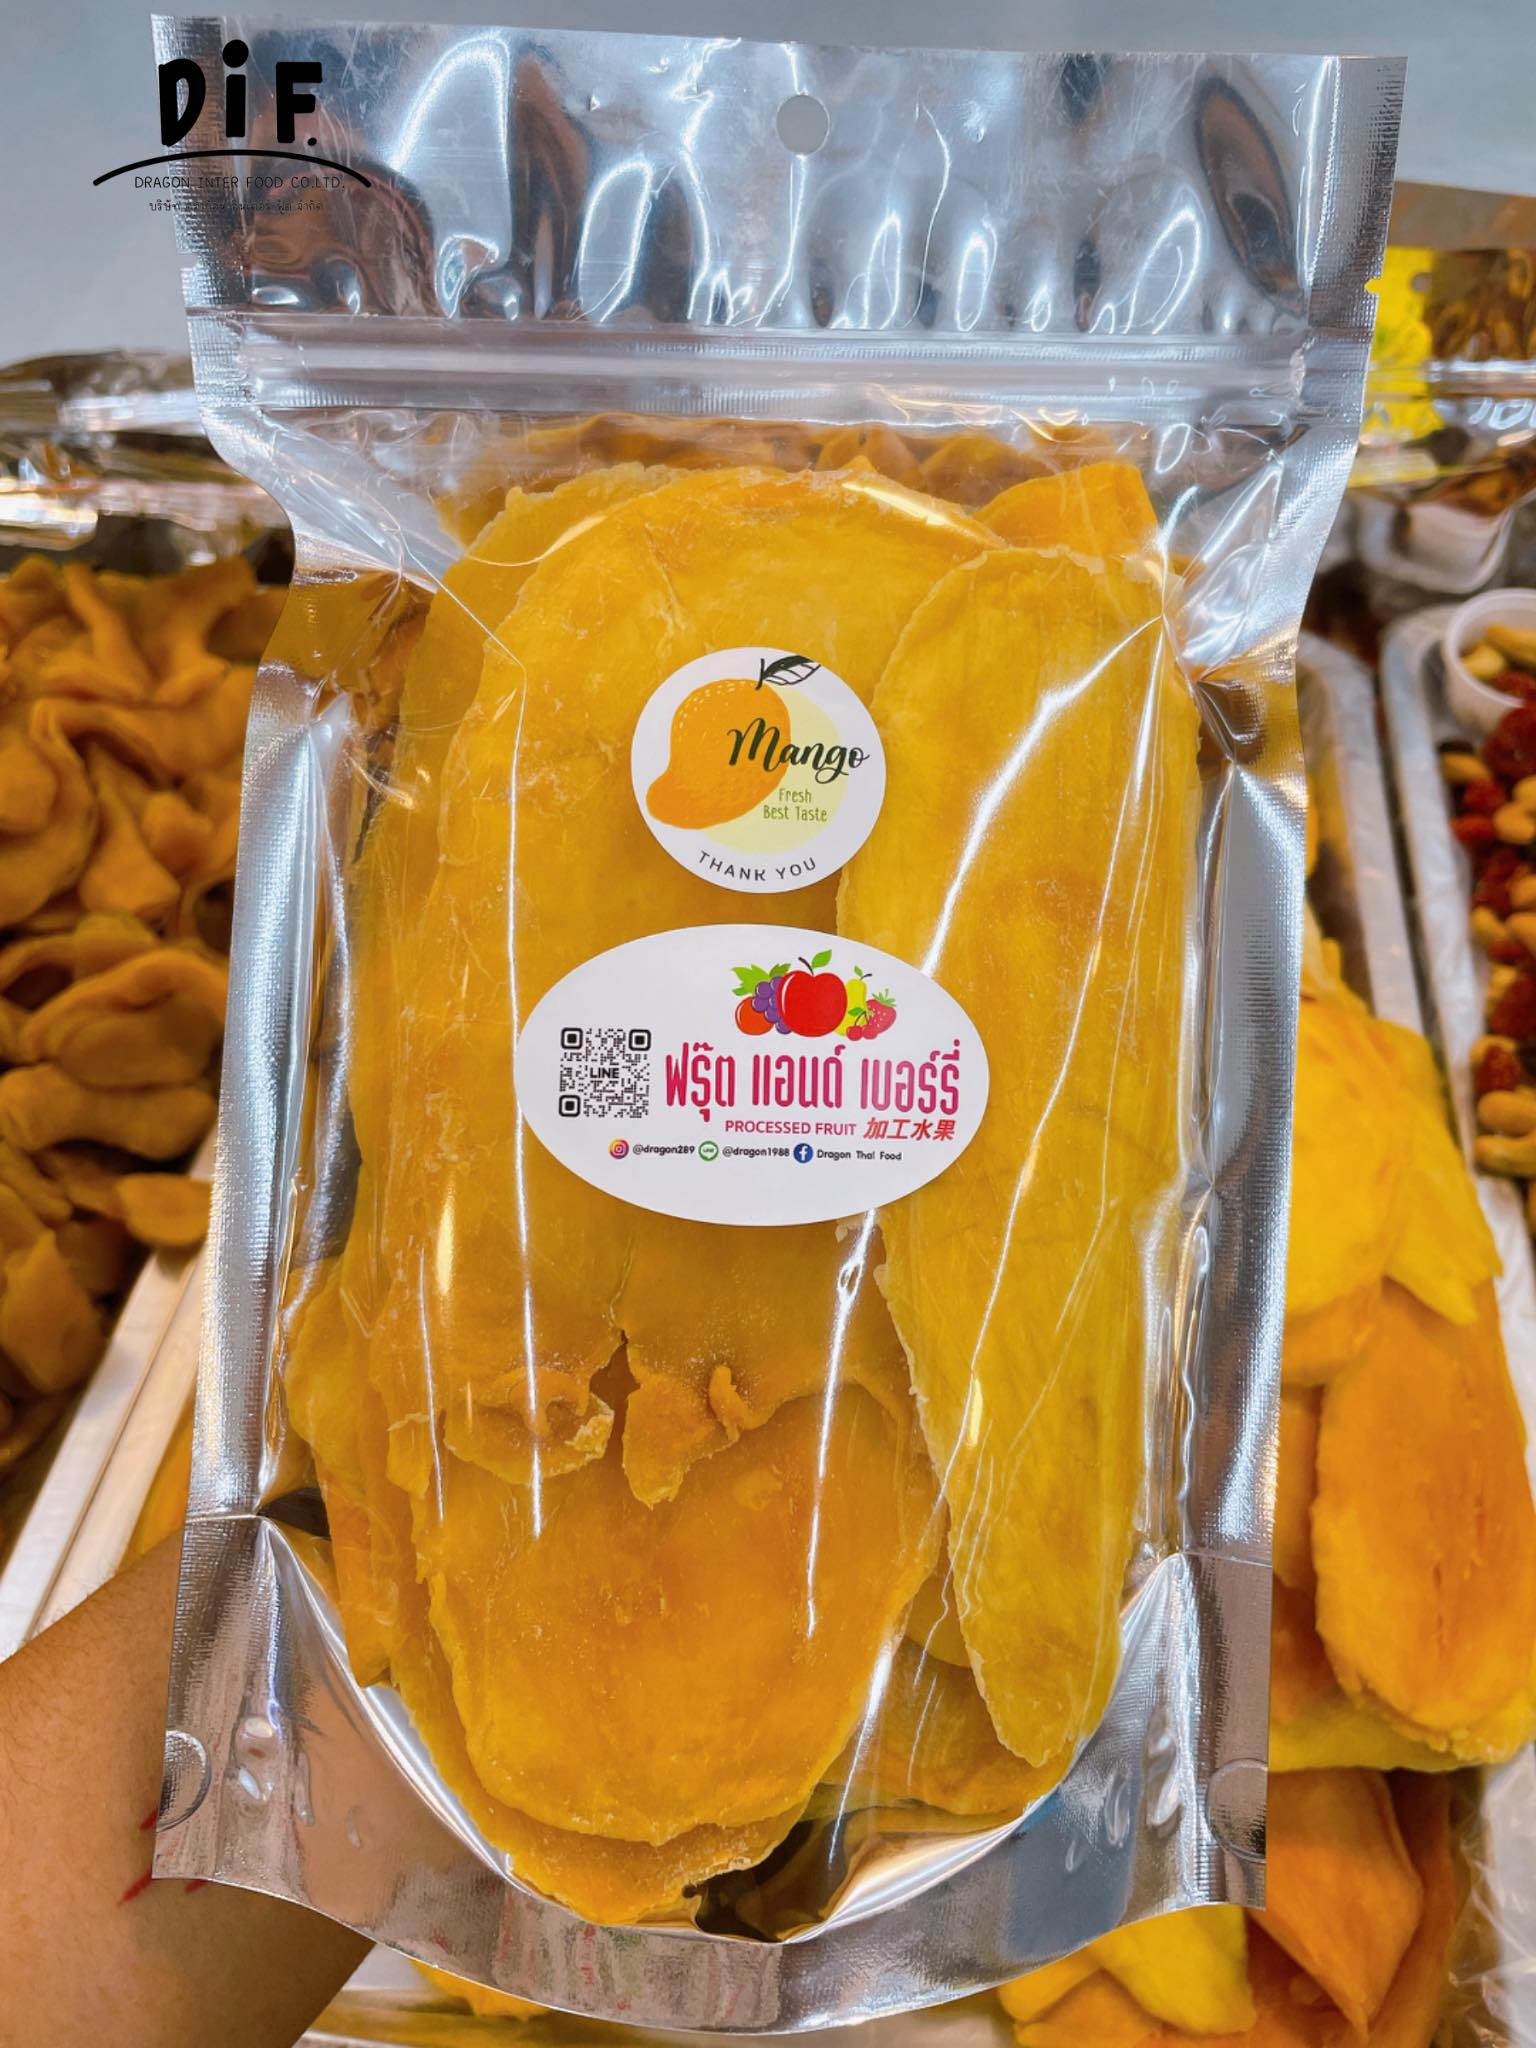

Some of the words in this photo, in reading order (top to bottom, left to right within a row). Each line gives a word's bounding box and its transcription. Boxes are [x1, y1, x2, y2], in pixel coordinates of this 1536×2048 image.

[726, 717, 871, 785] Mango
[778, 787, 812, 804] Fresh
[762, 804, 790, 821] Best
[794, 806, 828, 823] Taste
[698, 850, 767, 882] THANK
[775, 856, 817, 881] YOU
[590, 1067, 619, 1079] LINE
[752, 1043, 847, 1109] แอนด์
[860, 1038, 962, 1116] เบอร์รี่
[724, 1119, 811, 1136] PROCESSED
[814, 1121, 857, 1136] FRUIT
[863, 1116, 957, 1142] 加工水果
[632, 1143, 695, 1157] @dragon289
[722, 1145, 790, 1159] @dragon1988
[816, 1148, 851, 1162] Dragon
[856, 1150, 876, 1160] Thai
[880, 1151, 903, 1161] Food
